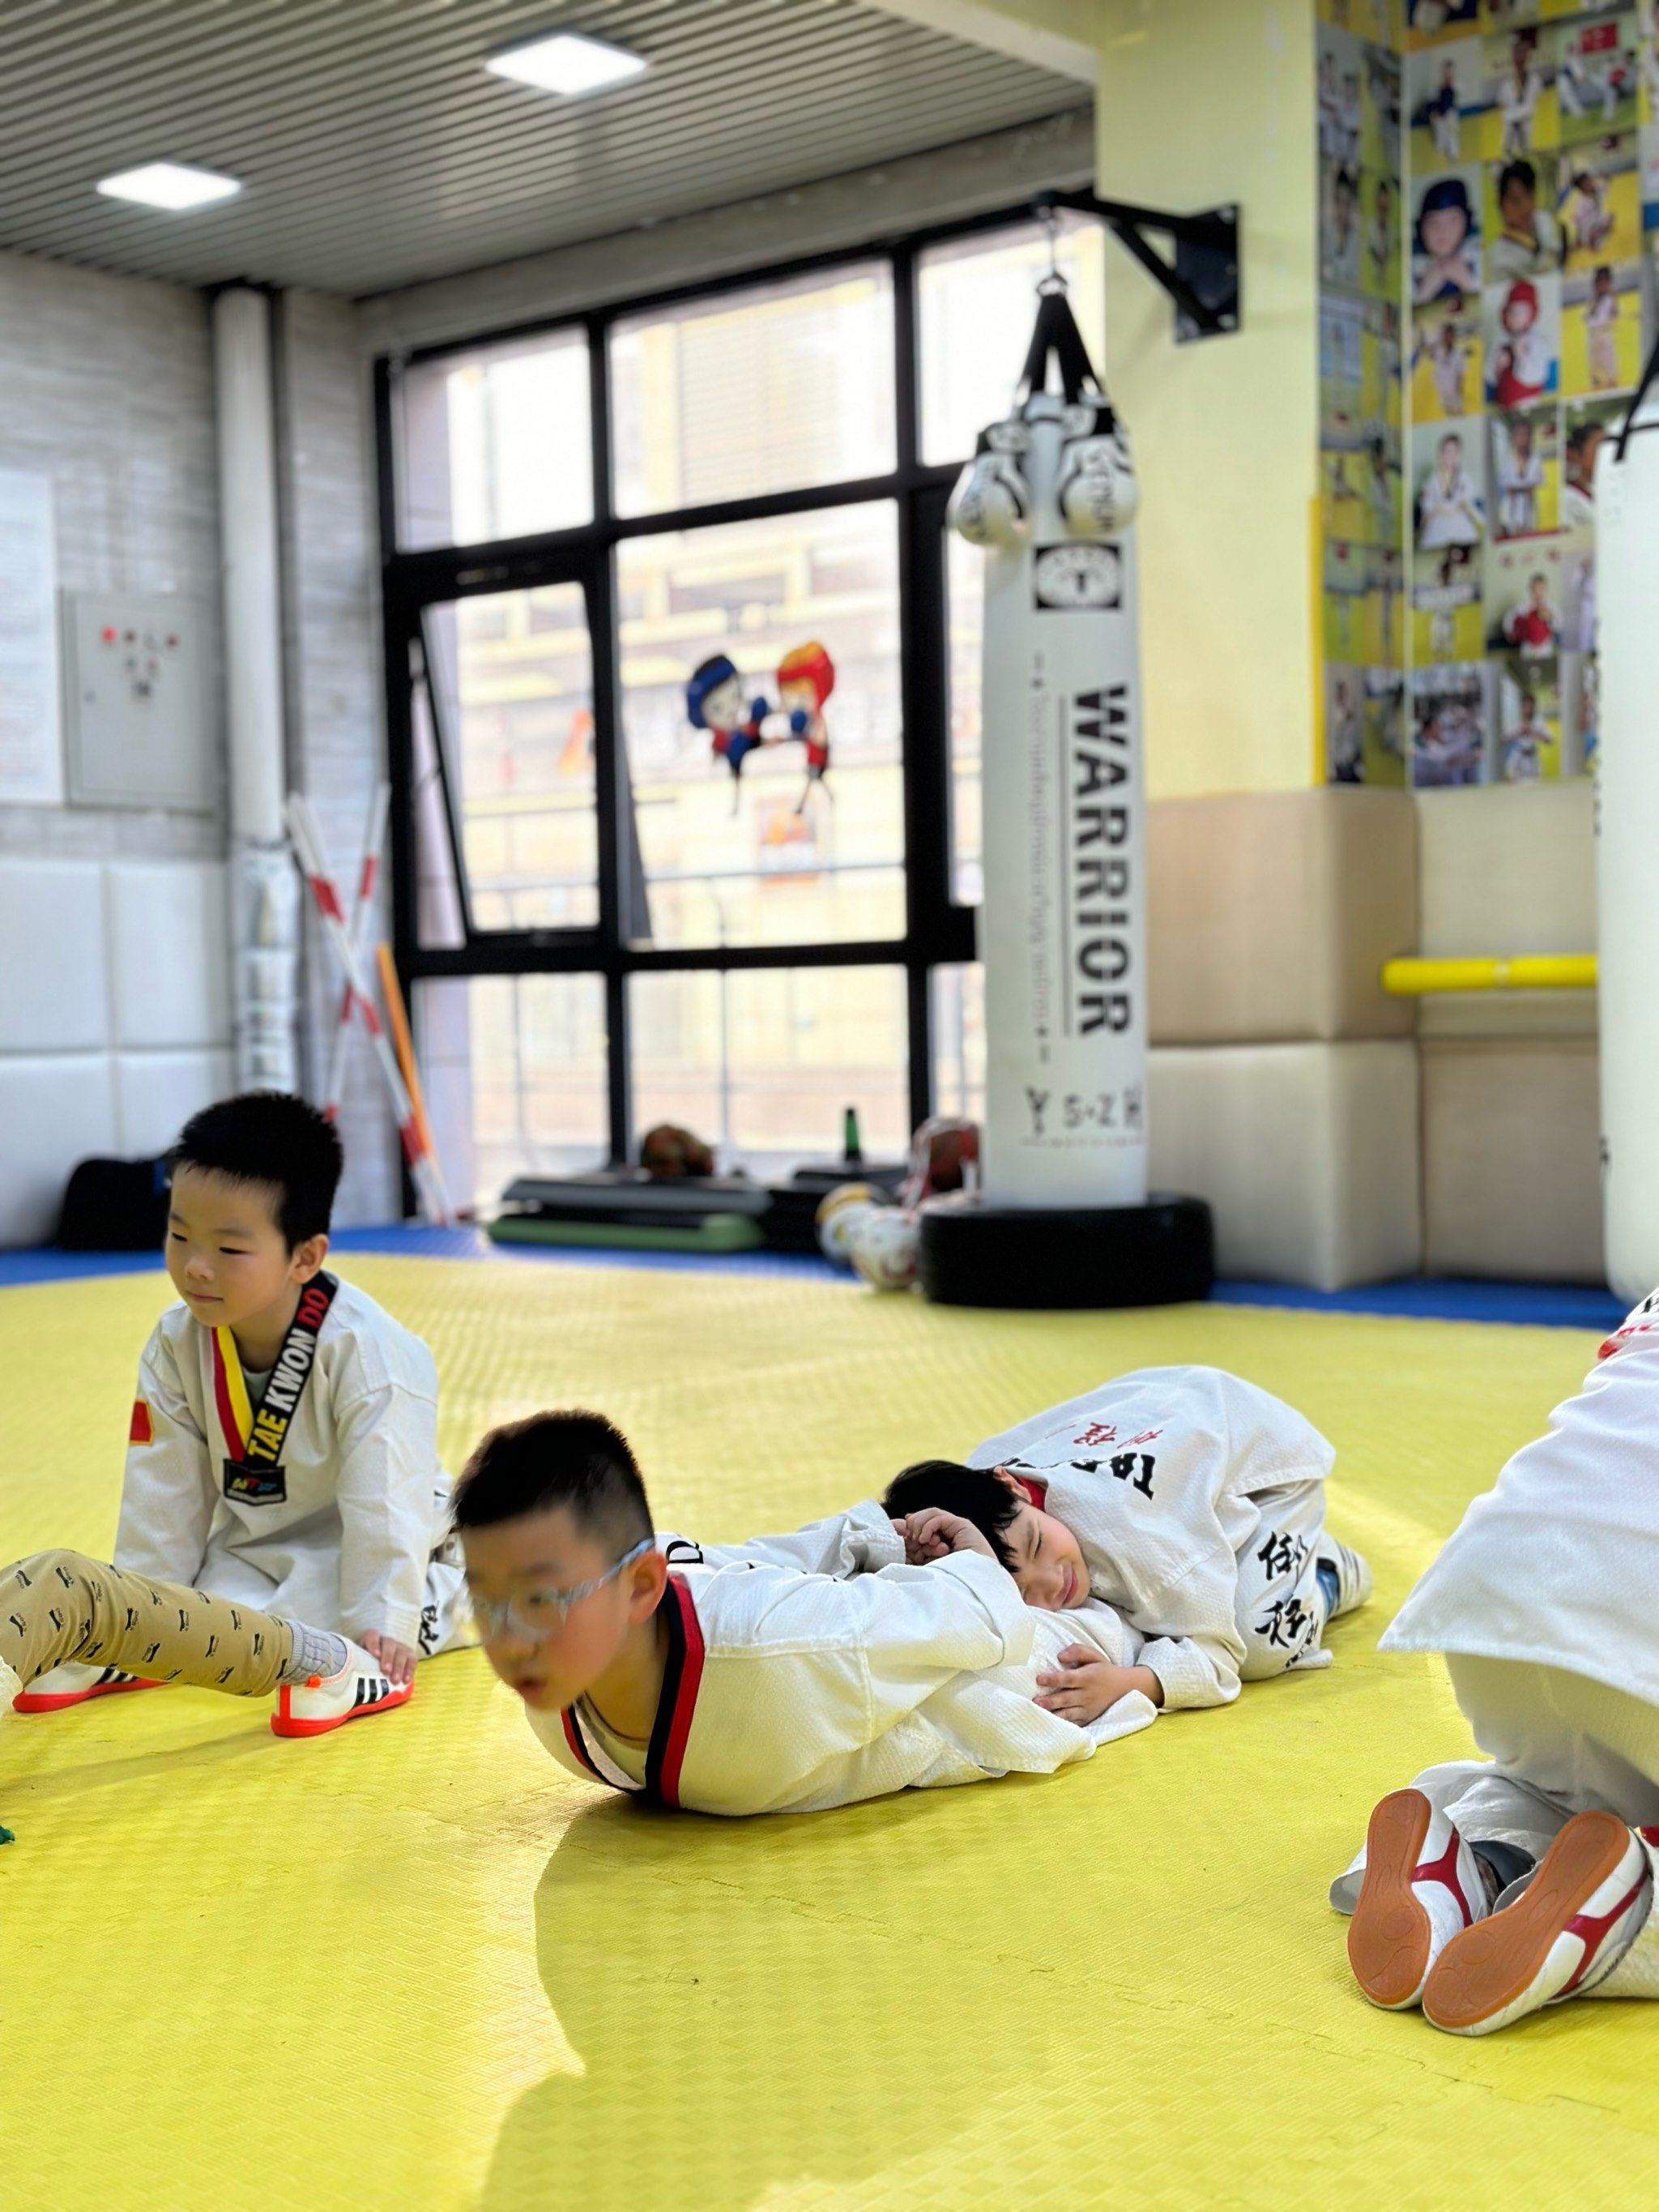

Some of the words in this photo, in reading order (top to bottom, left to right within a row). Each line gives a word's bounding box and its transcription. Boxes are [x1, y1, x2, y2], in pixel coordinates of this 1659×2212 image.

[1075, 683, 1130, 1036] WARRIOR
[298, 1289, 329, 1326] DO
[265, 1330, 315, 1412] KWON
[249, 1408, 287, 1461] TAE
